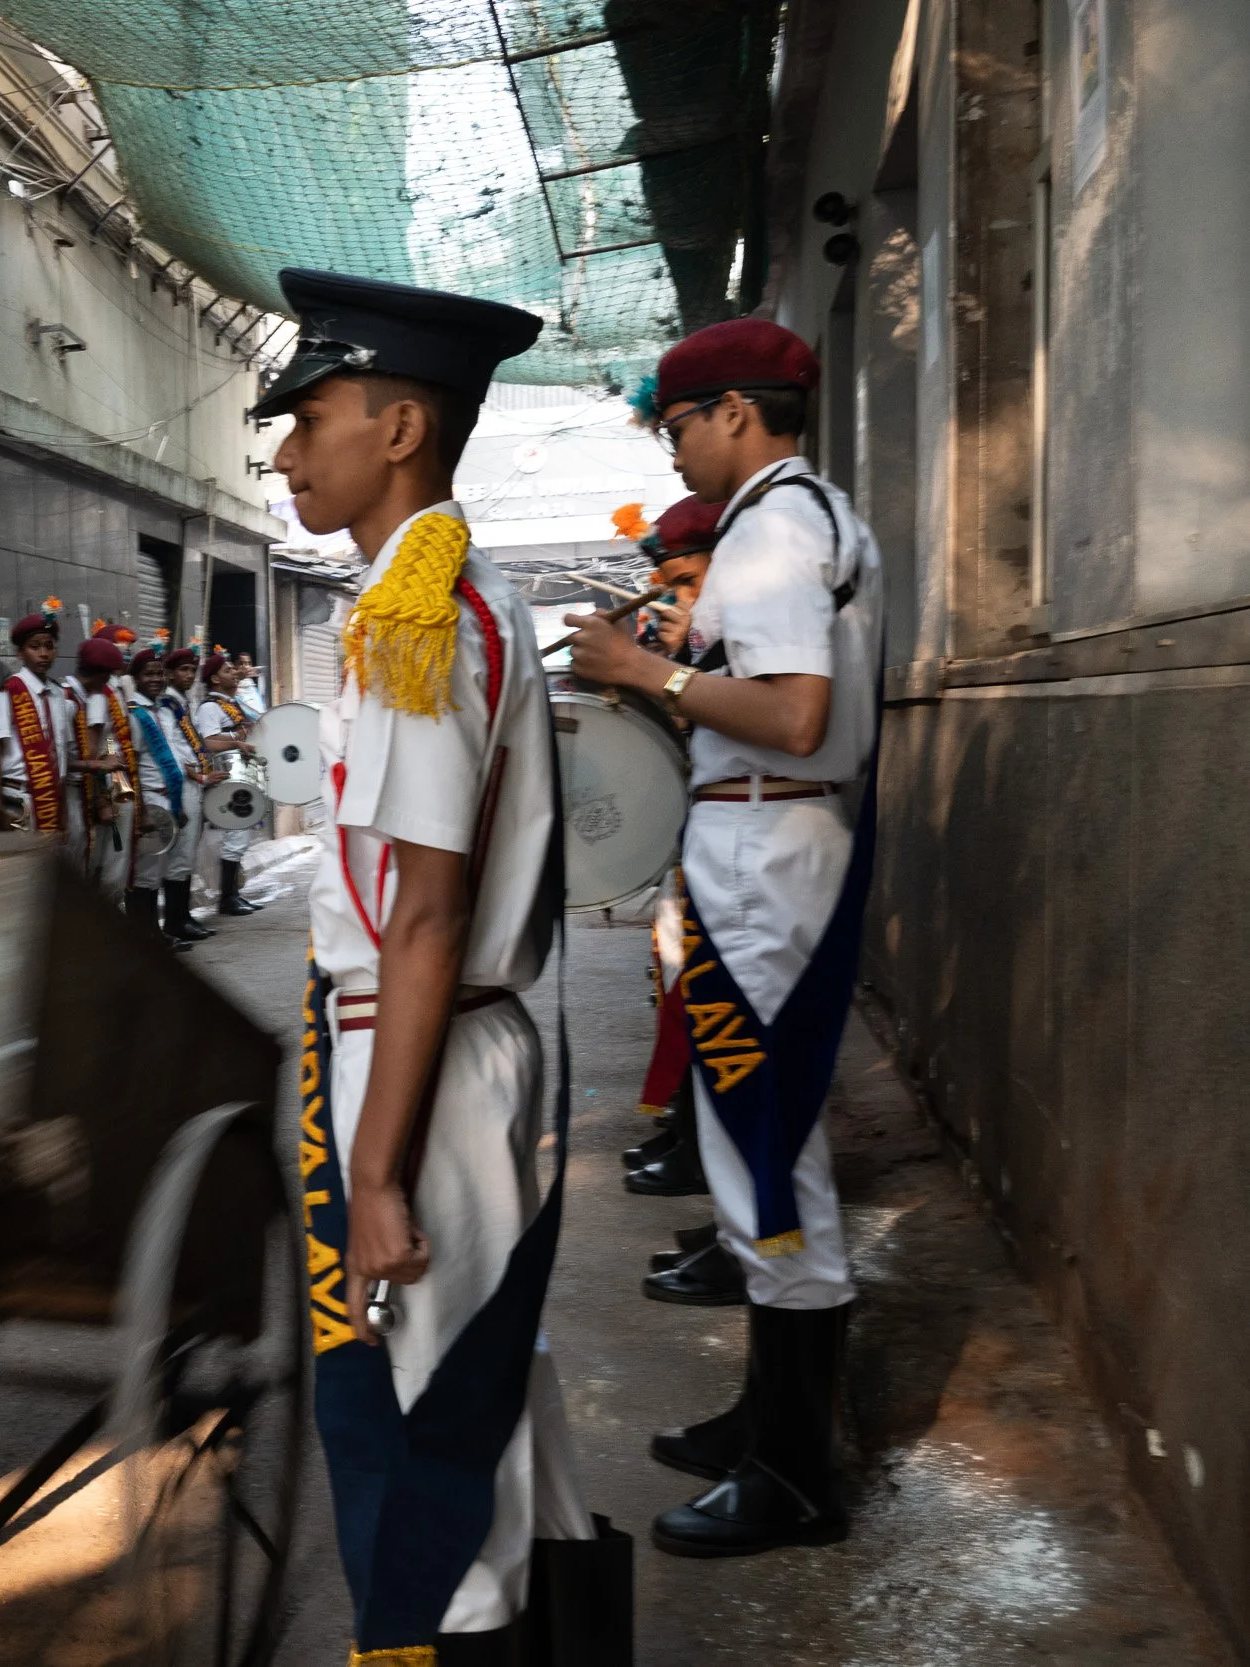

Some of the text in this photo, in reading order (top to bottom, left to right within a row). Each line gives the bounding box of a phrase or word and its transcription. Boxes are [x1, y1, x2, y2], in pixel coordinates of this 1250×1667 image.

[13, 692, 58, 833] SHREE JAIN VIDY
